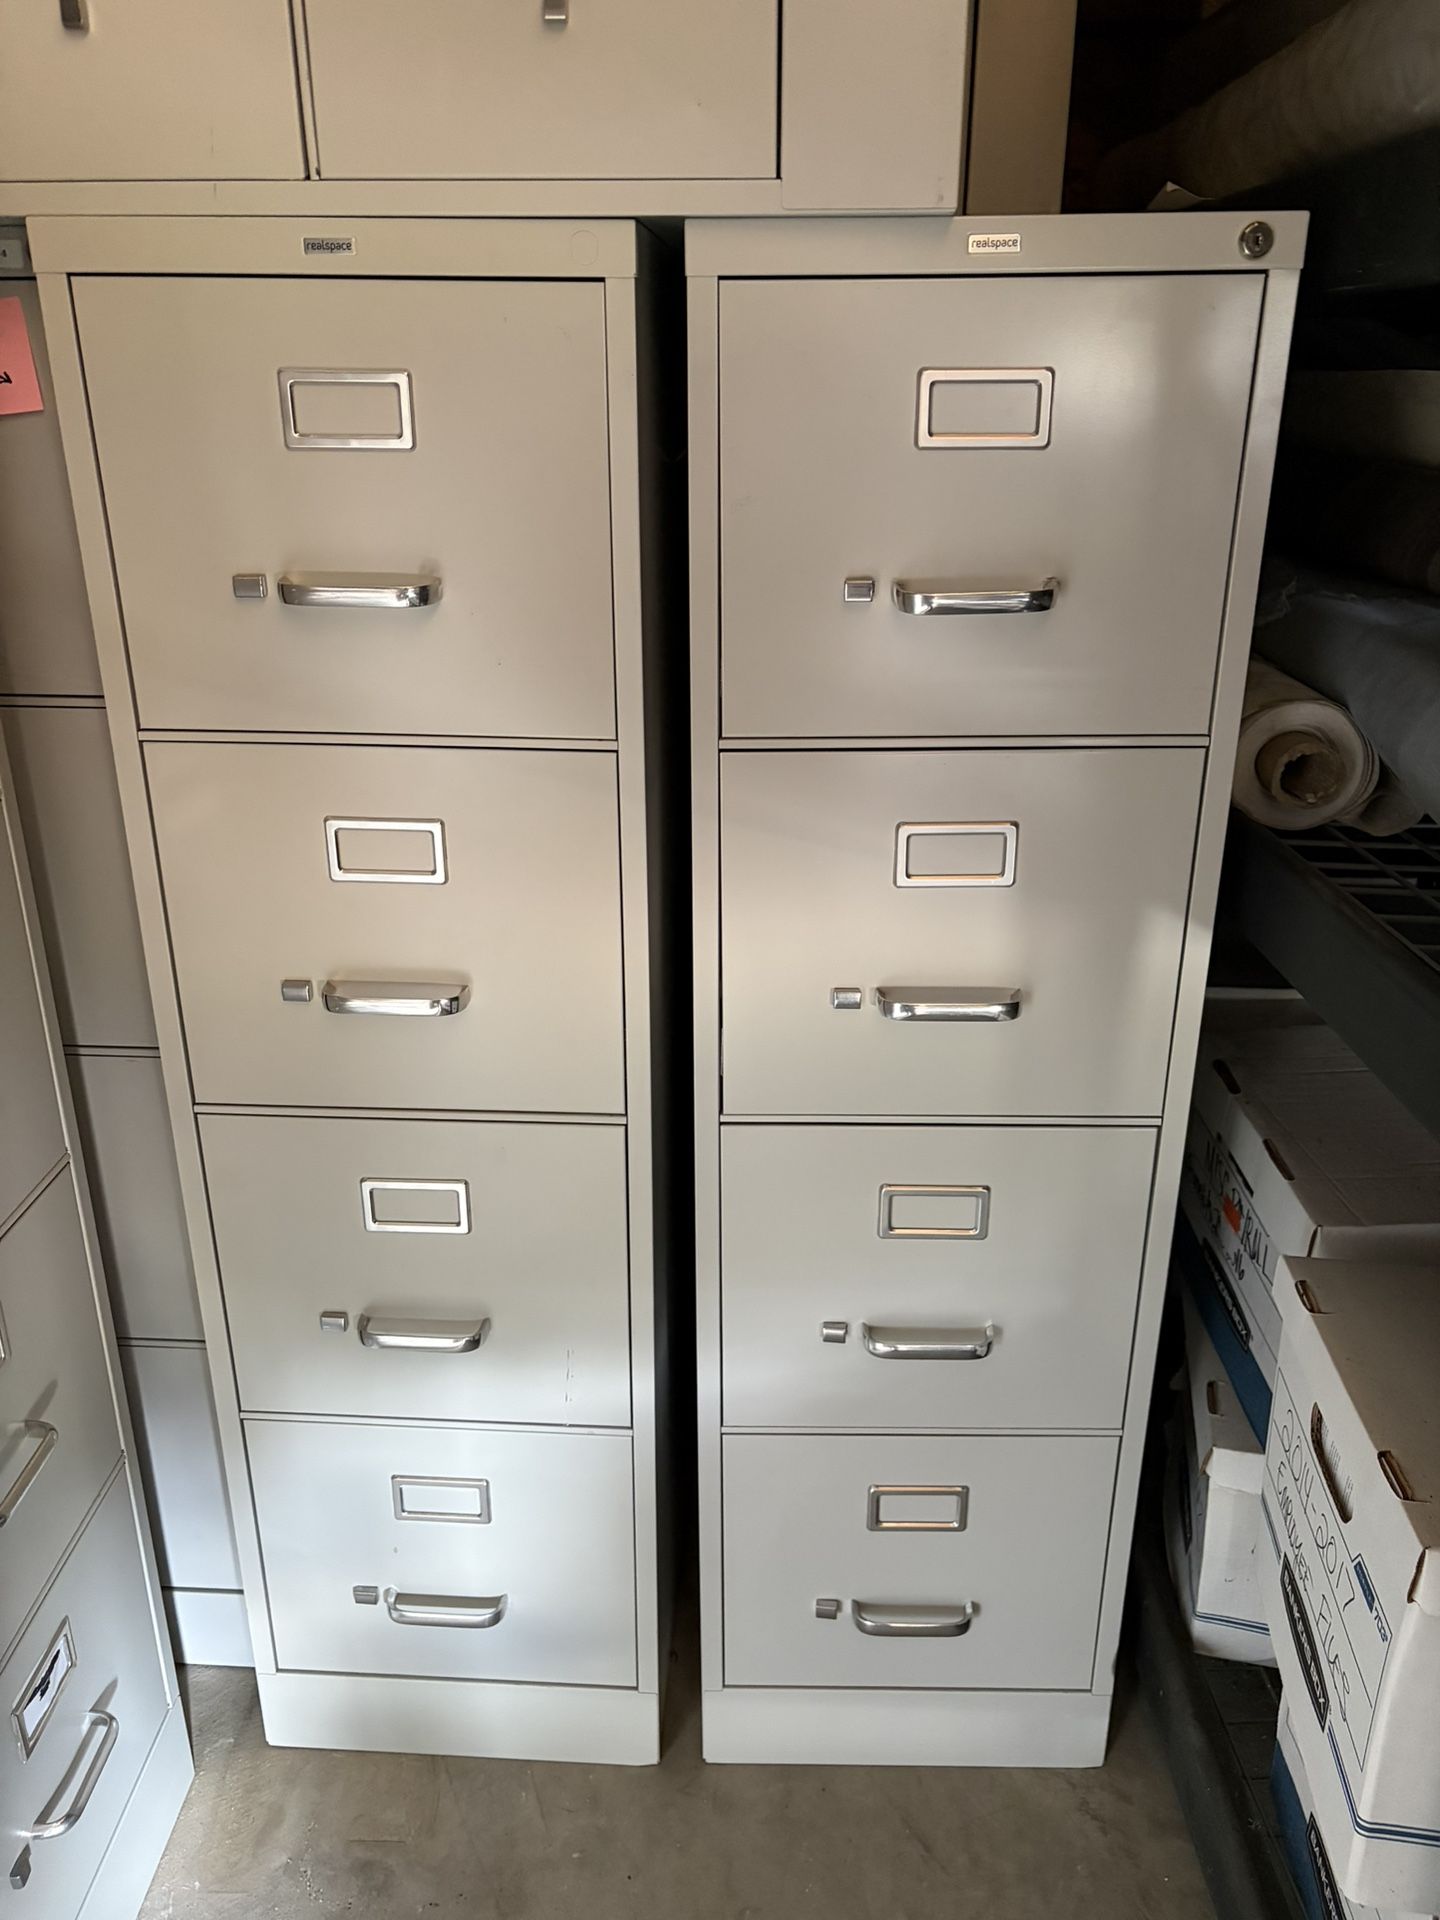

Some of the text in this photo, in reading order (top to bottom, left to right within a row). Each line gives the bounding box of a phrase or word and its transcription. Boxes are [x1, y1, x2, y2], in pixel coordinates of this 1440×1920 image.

[306, 240, 352, 253] realspace
[971, 237, 1018, 250] realspace
[1284, 1568, 1325, 1713] BANKERS BOX
